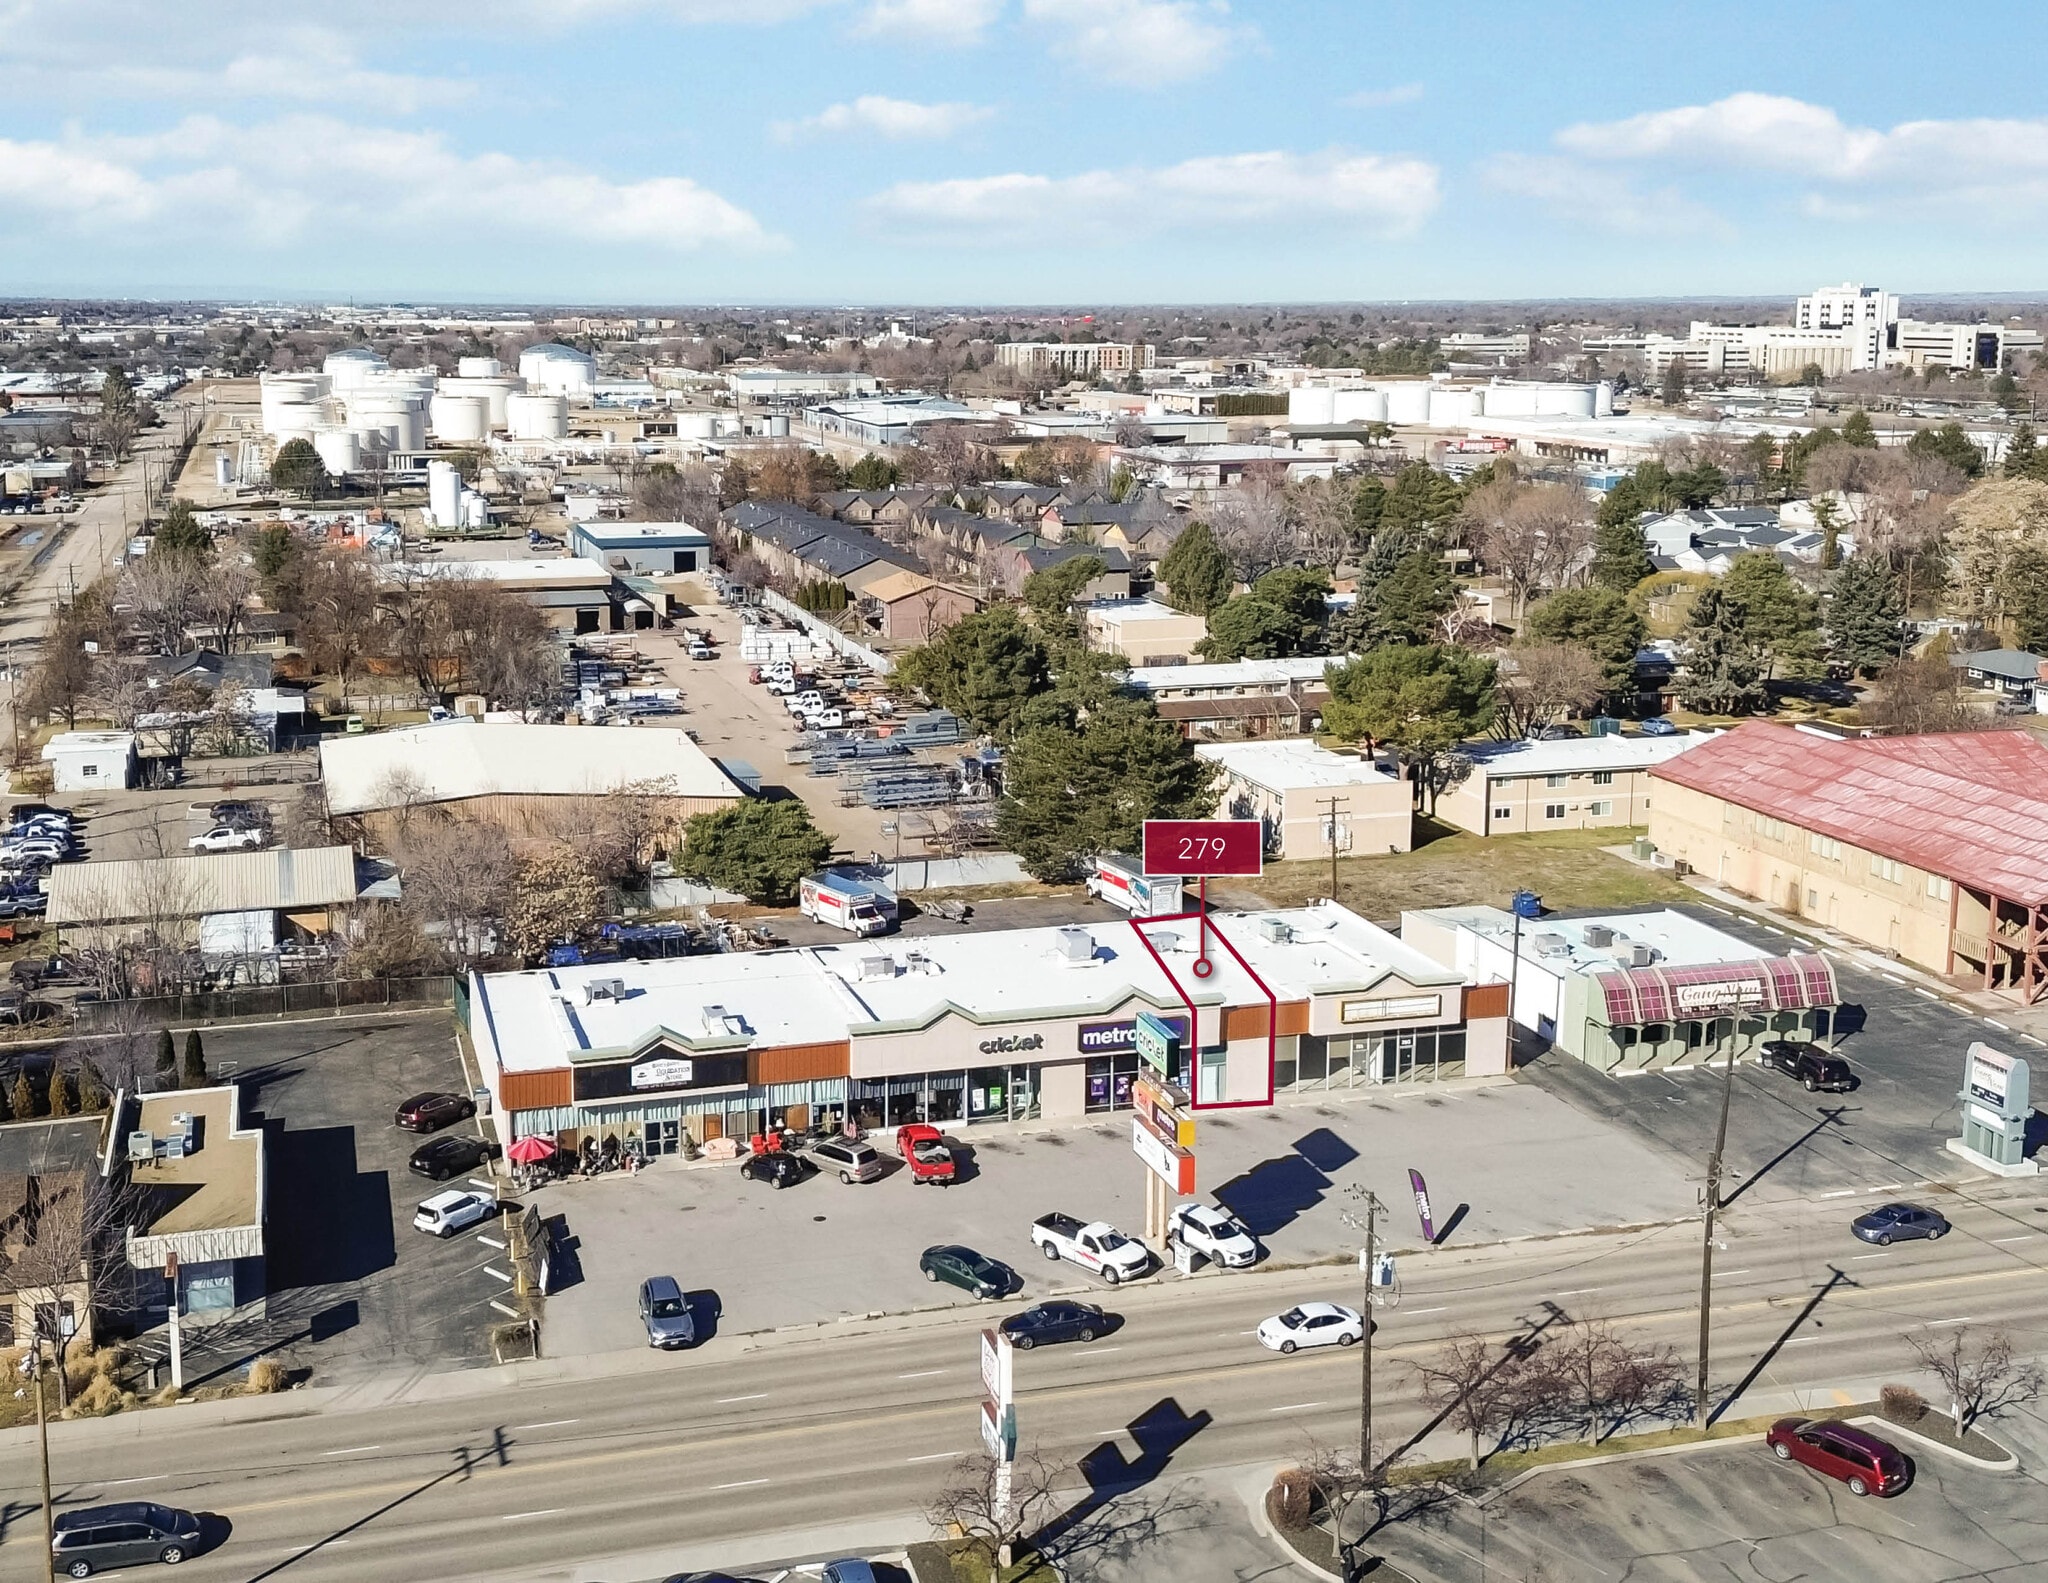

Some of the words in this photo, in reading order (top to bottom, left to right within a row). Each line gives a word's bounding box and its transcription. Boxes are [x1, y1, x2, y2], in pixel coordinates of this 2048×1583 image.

[979, 1034, 1044, 1054] cricket
[1083, 1027, 1137, 1046] metro
[1139, 1032, 1165, 1061] cricket
[1418, 1191, 1431, 1220] metro
